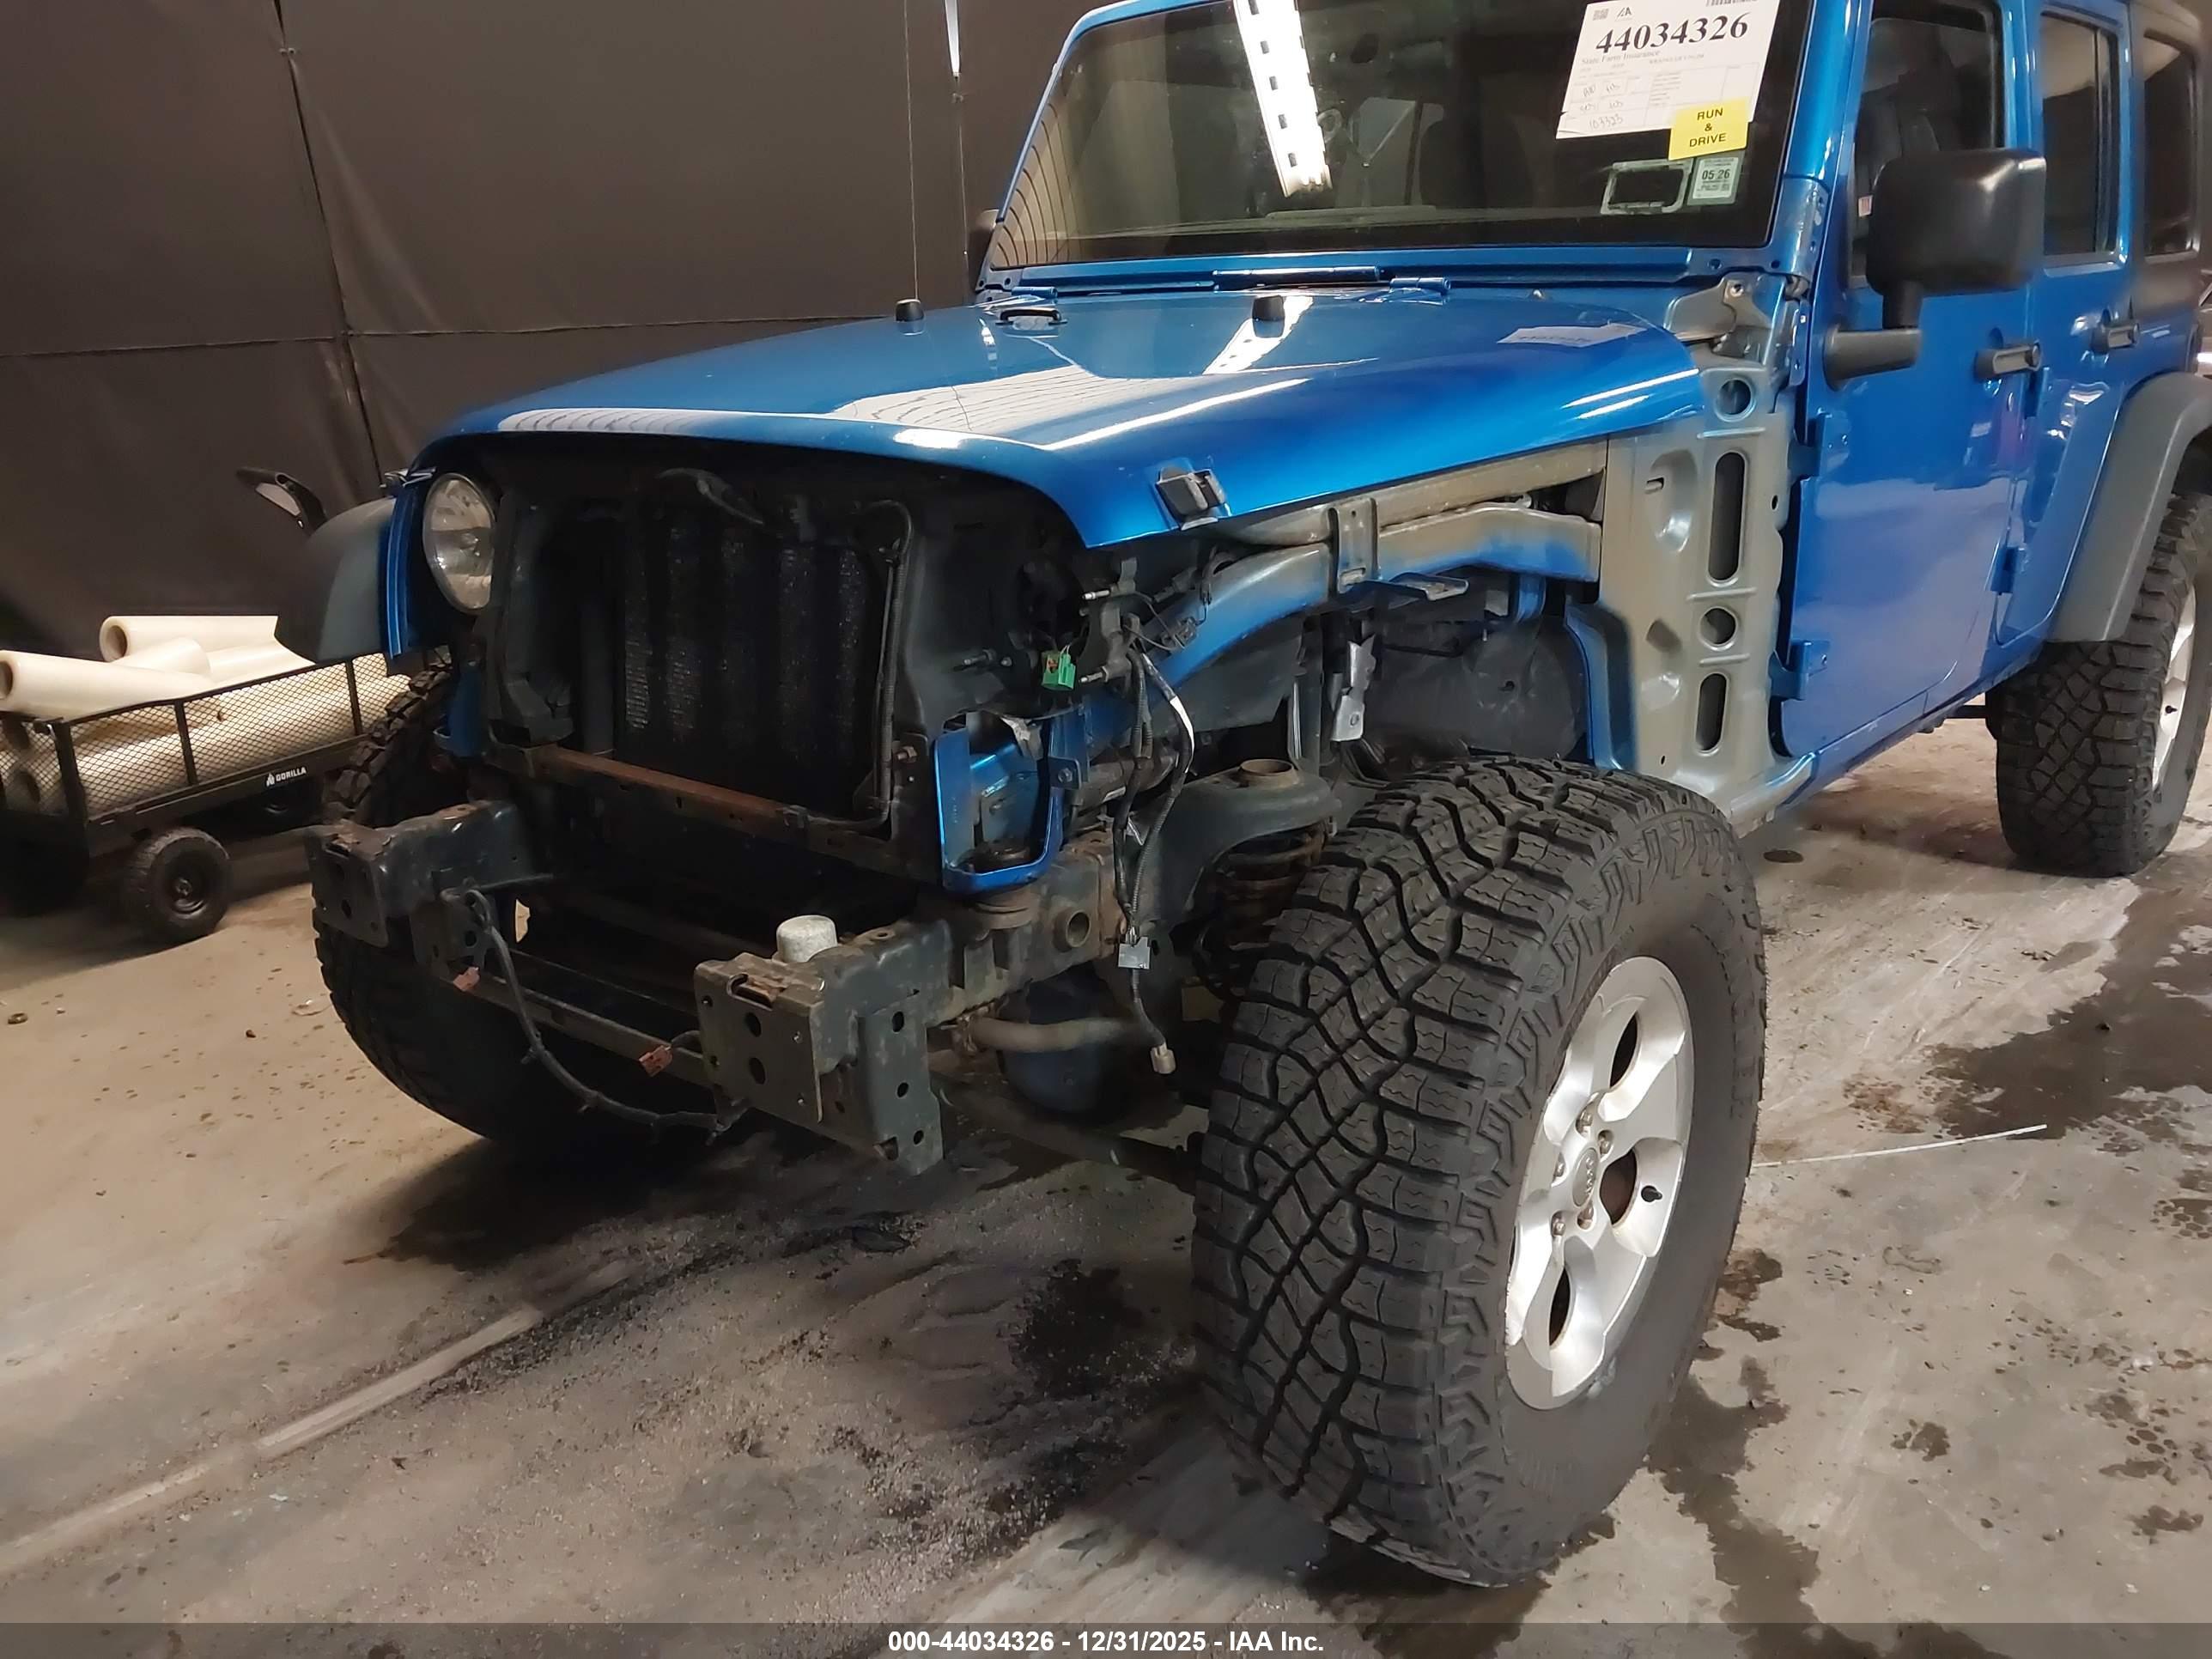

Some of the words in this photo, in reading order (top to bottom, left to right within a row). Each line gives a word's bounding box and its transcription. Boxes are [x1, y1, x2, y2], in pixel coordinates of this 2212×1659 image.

[1595, 13, 1751, 54] 44034326
[1697, 107, 1723, 121] RUN
[1705, 123, 1713, 131] &
[1689, 132, 1727, 148] DRIVE
[1702, 170, 1715, 180] 05
[1717, 168, 1731, 179] 26
[276, 767, 307, 782] GORILLA
